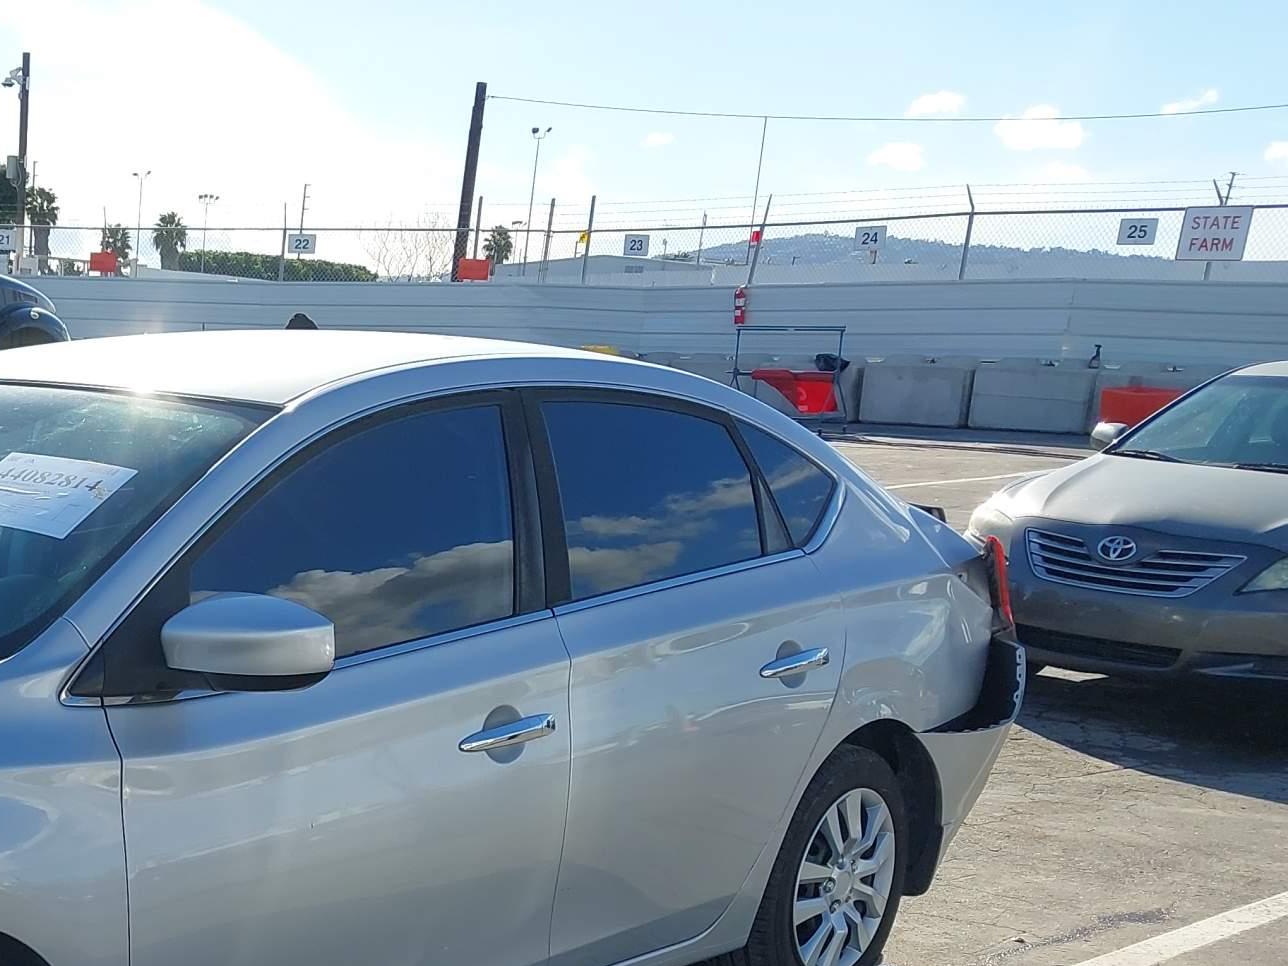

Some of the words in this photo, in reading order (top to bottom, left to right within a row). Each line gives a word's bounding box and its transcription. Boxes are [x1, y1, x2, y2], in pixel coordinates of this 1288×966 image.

[1191, 215, 1242, 230] STATE
[861, 231, 878, 245] 24
[1127, 224, 1148, 239] 25
[294, 238, 310, 250] 22
[629, 239, 643, 251] 23
[1188, 237, 1234, 252] FARM
